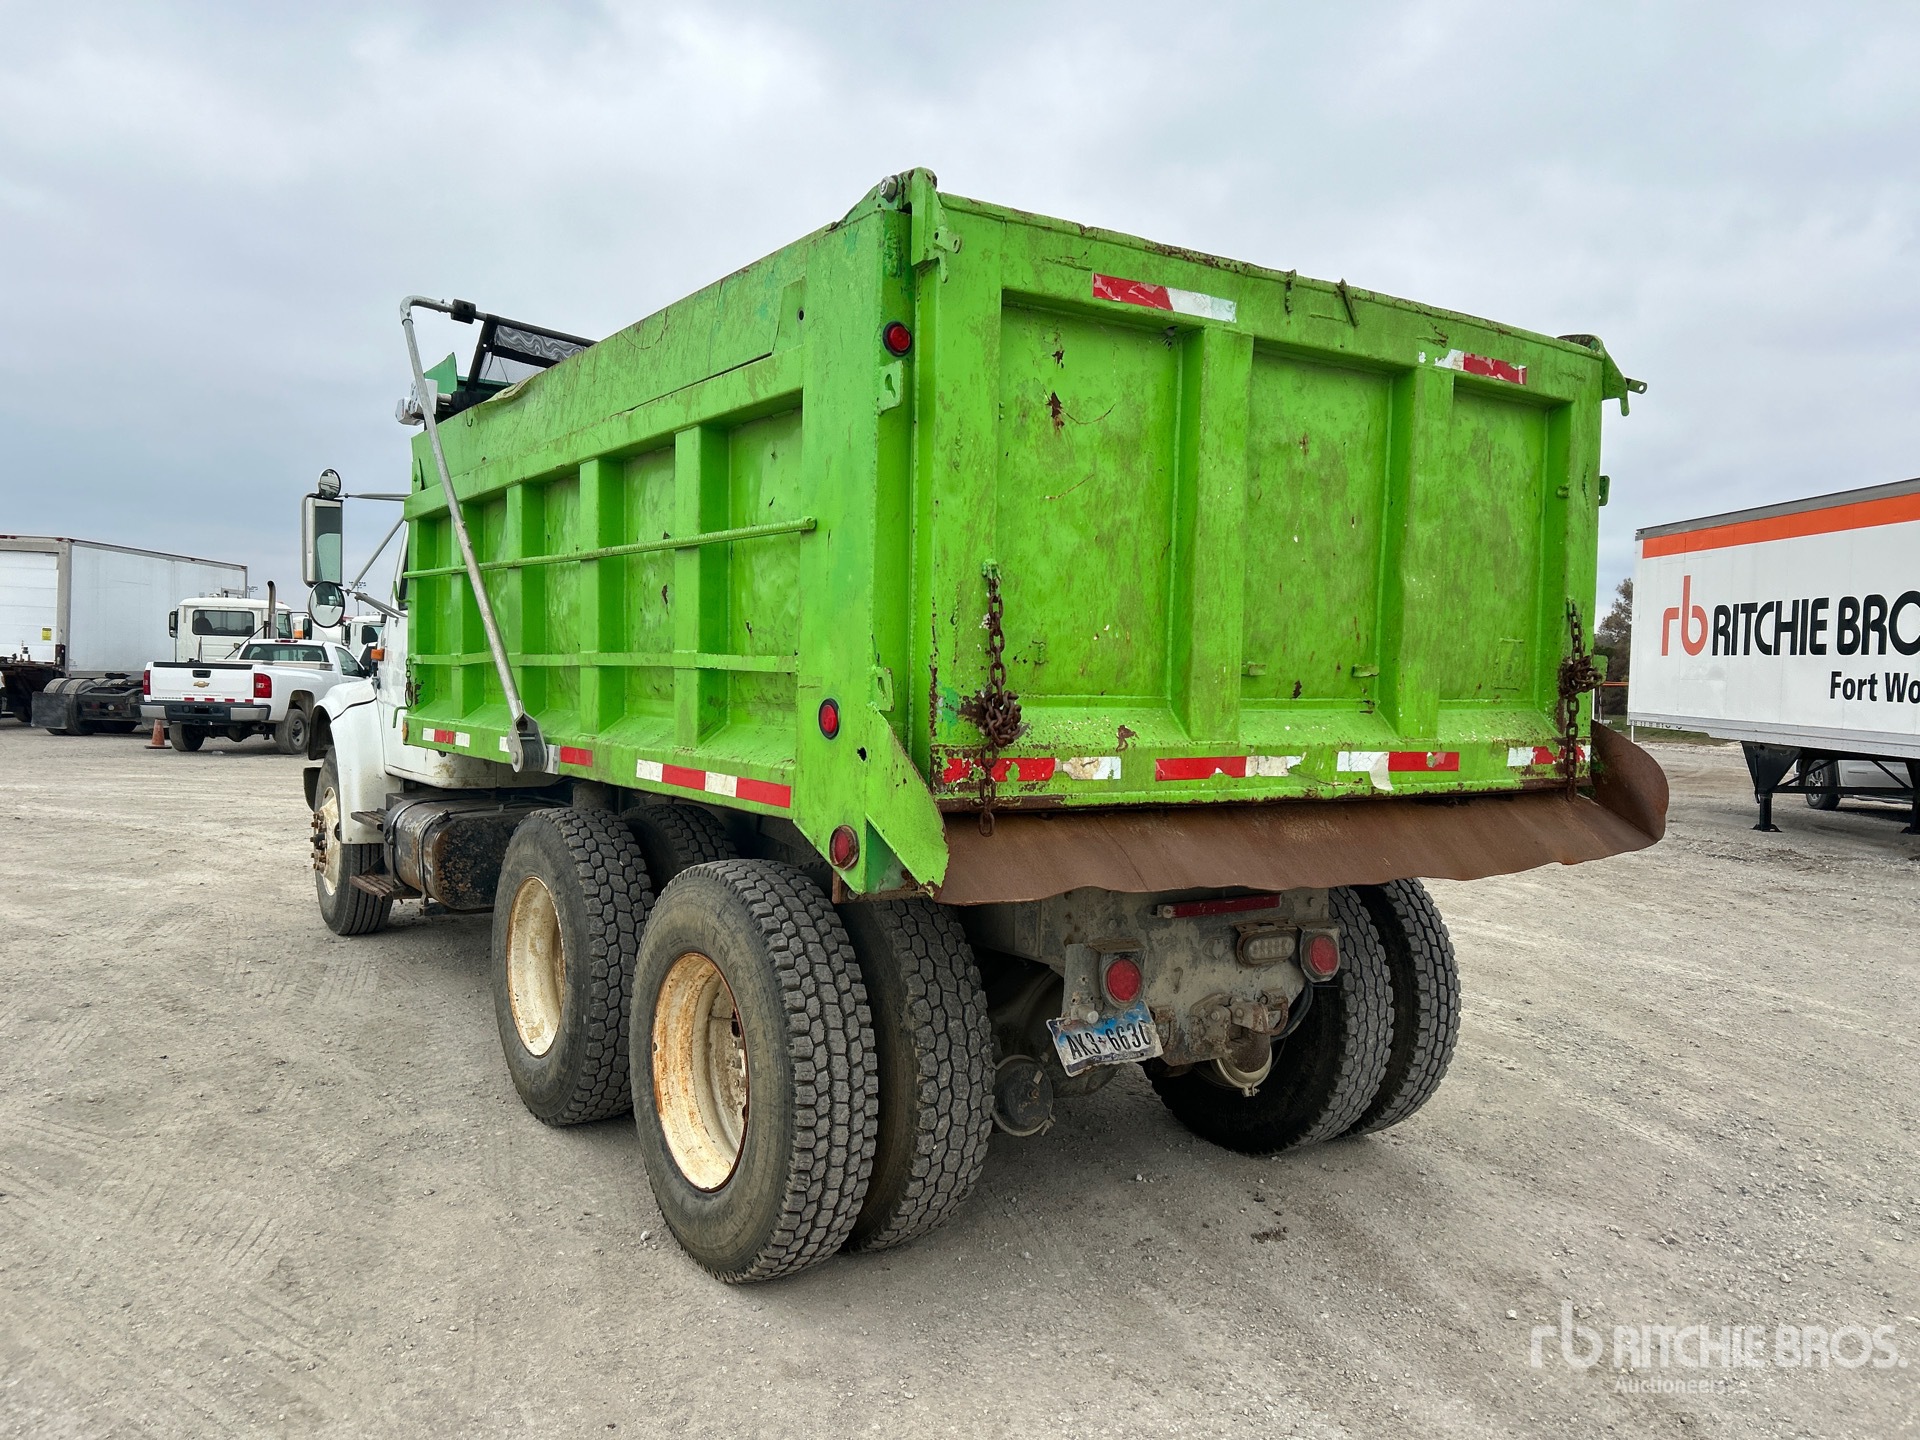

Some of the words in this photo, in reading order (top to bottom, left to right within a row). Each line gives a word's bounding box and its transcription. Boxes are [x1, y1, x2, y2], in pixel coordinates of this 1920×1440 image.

[1661, 575, 1708, 656] rb
[1712, 597, 1829, 656] RITCHIE
[1830, 671, 1878, 702] Fort
[1885, 672, 1920, 704] Wo
